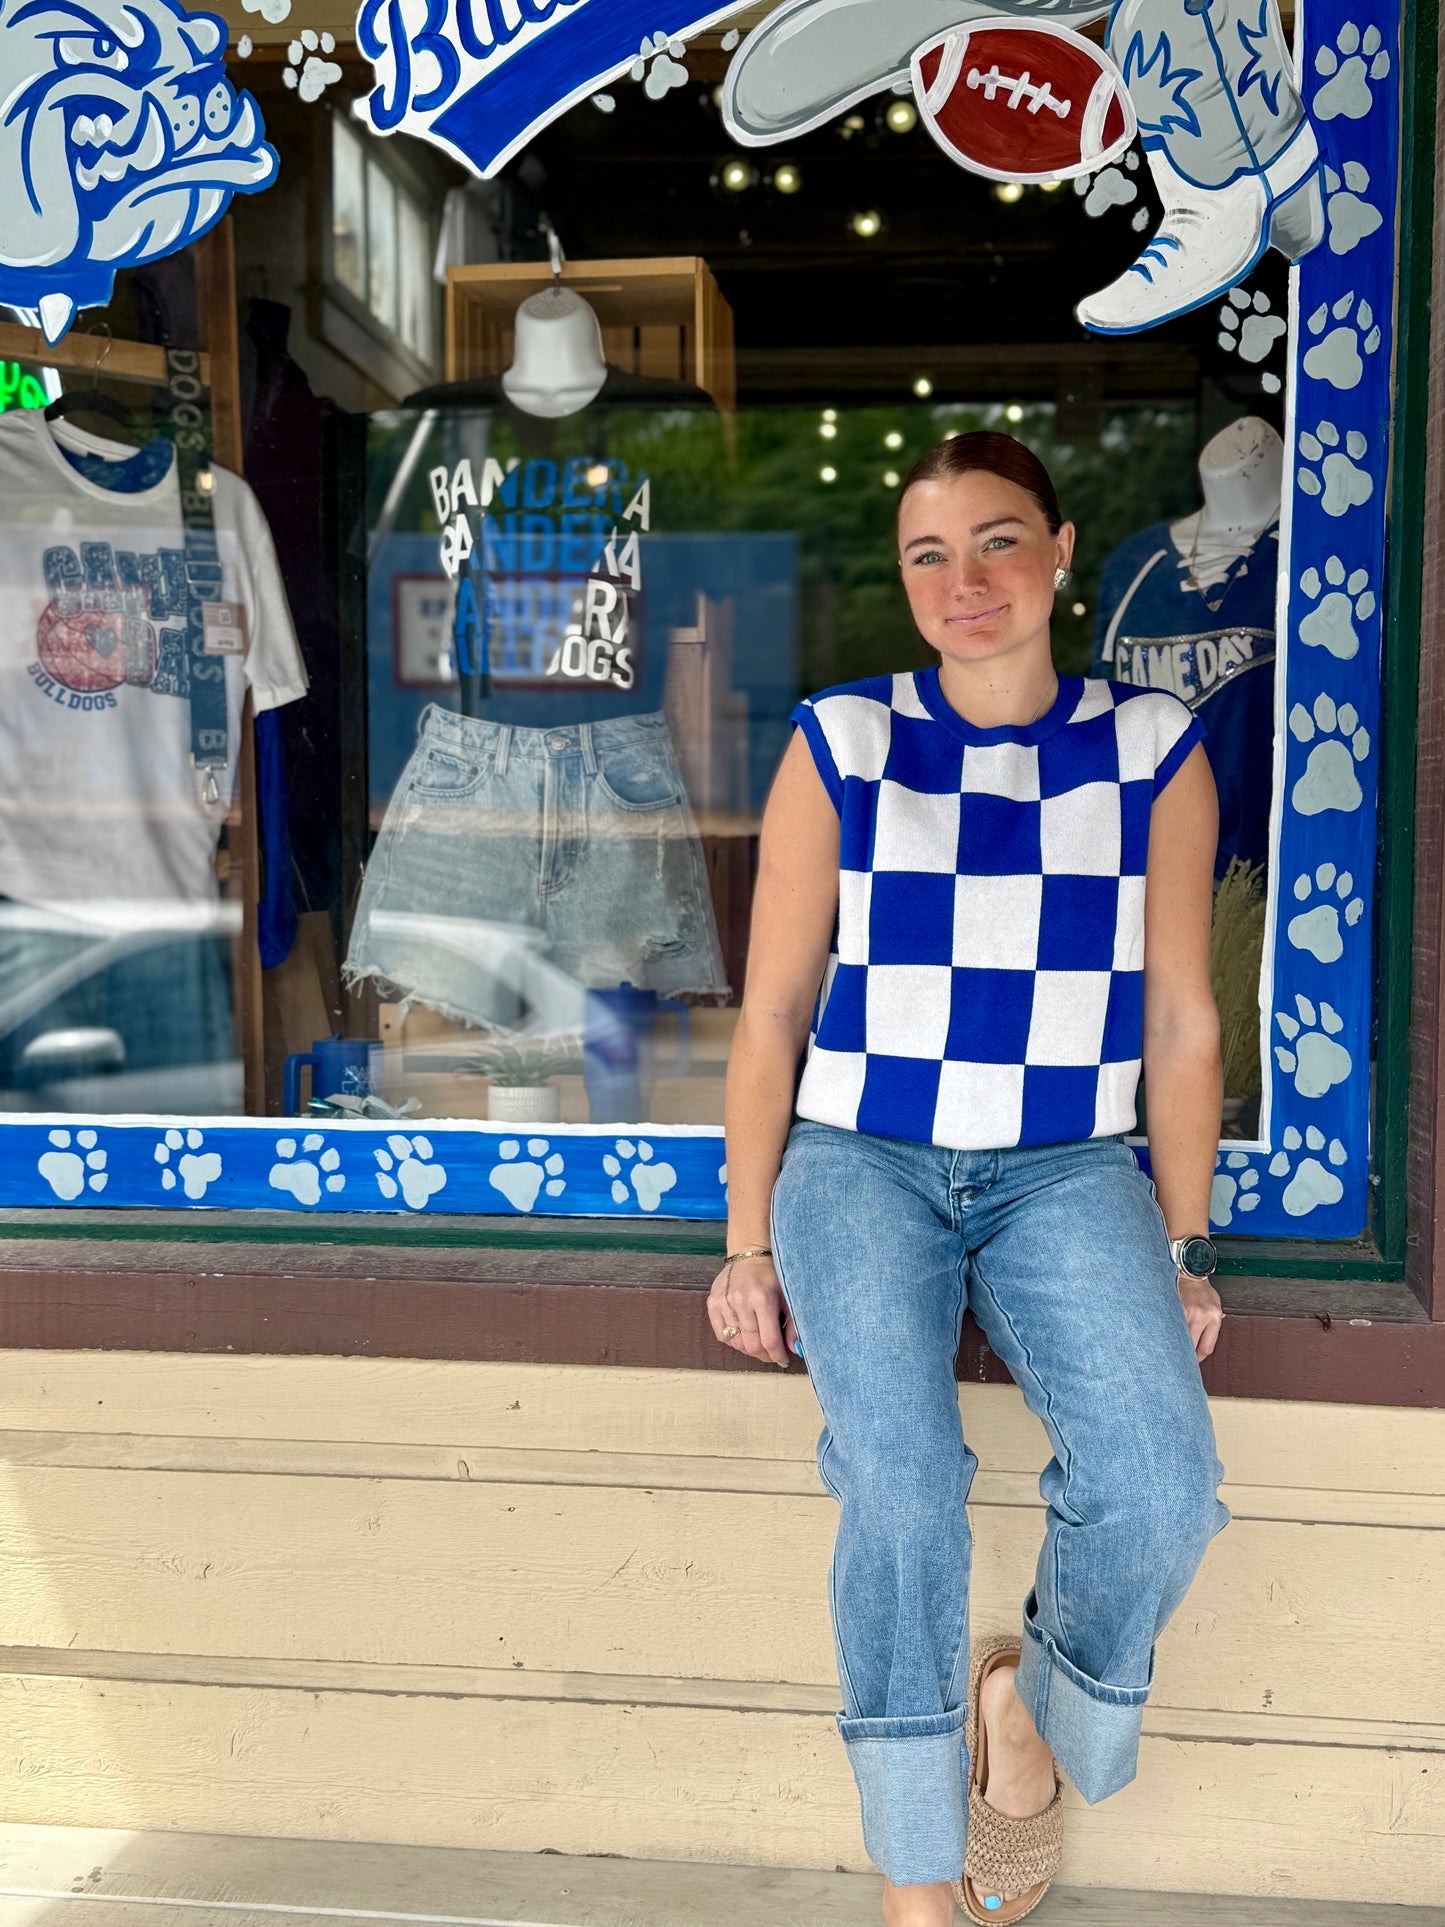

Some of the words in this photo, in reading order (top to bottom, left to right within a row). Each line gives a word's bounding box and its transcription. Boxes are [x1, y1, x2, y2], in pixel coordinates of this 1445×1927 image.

[430, 457, 650, 532] BANDERA
[446, 576, 630, 644] ANDER
[27, 660, 118, 712] BULLDOGS
[1115, 642, 1197, 703] GAME
[1196, 634, 1254, 689] DAY
